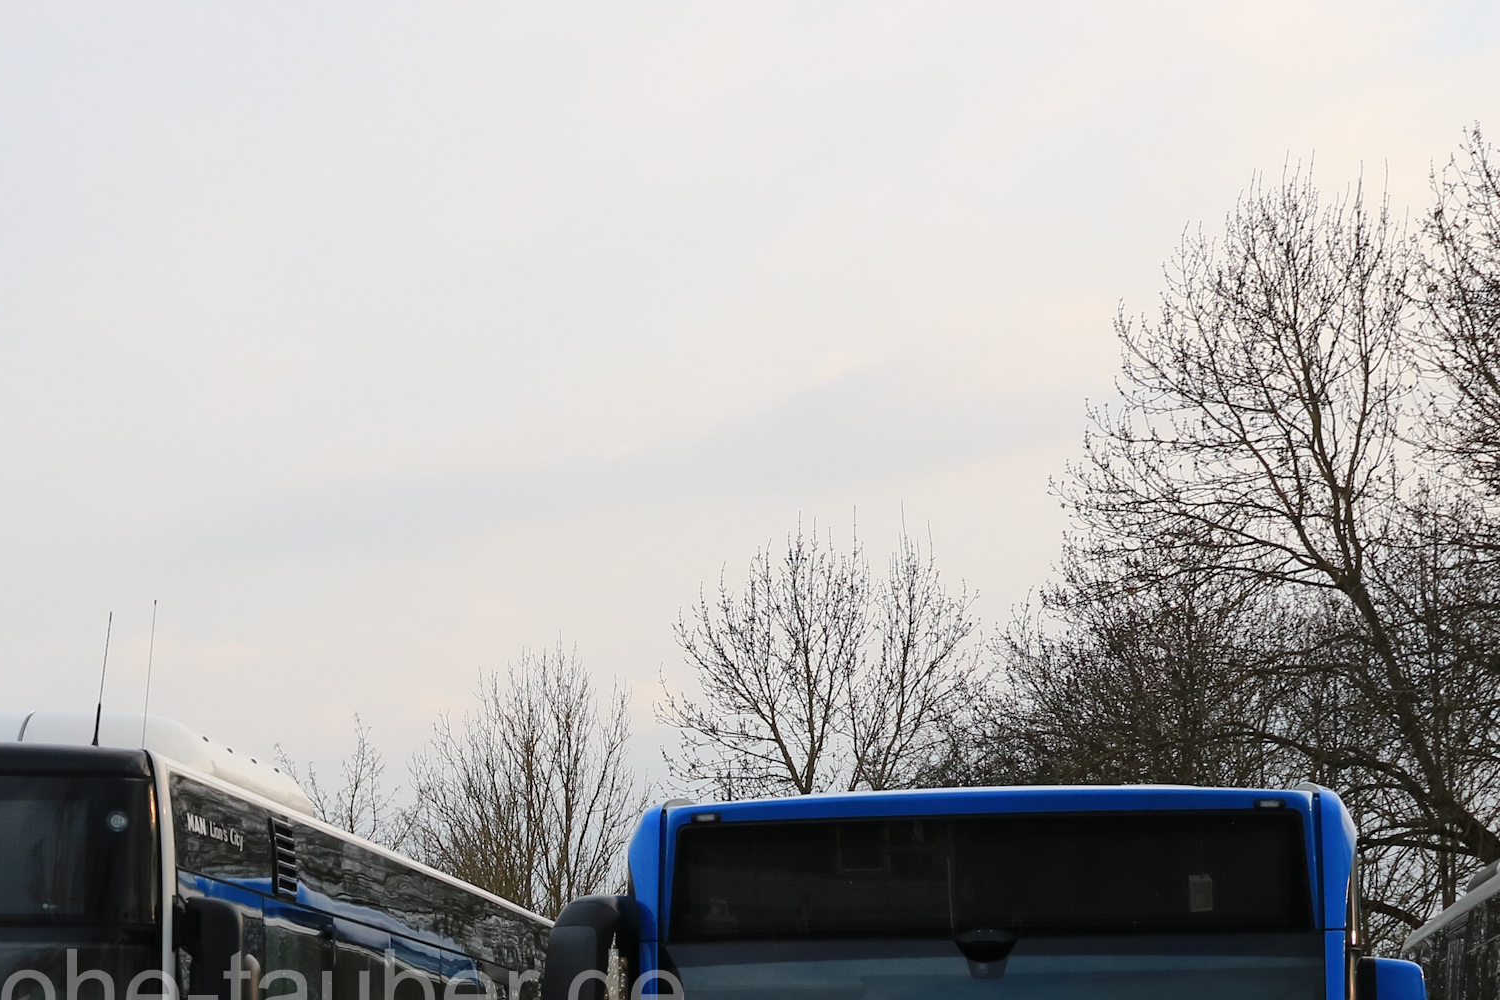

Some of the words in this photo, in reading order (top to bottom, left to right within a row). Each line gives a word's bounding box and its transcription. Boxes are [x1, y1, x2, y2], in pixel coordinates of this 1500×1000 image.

[186, 812, 207, 836] MAN
[209, 821, 228, 842] Lion's
[229, 828, 244, 852] City
